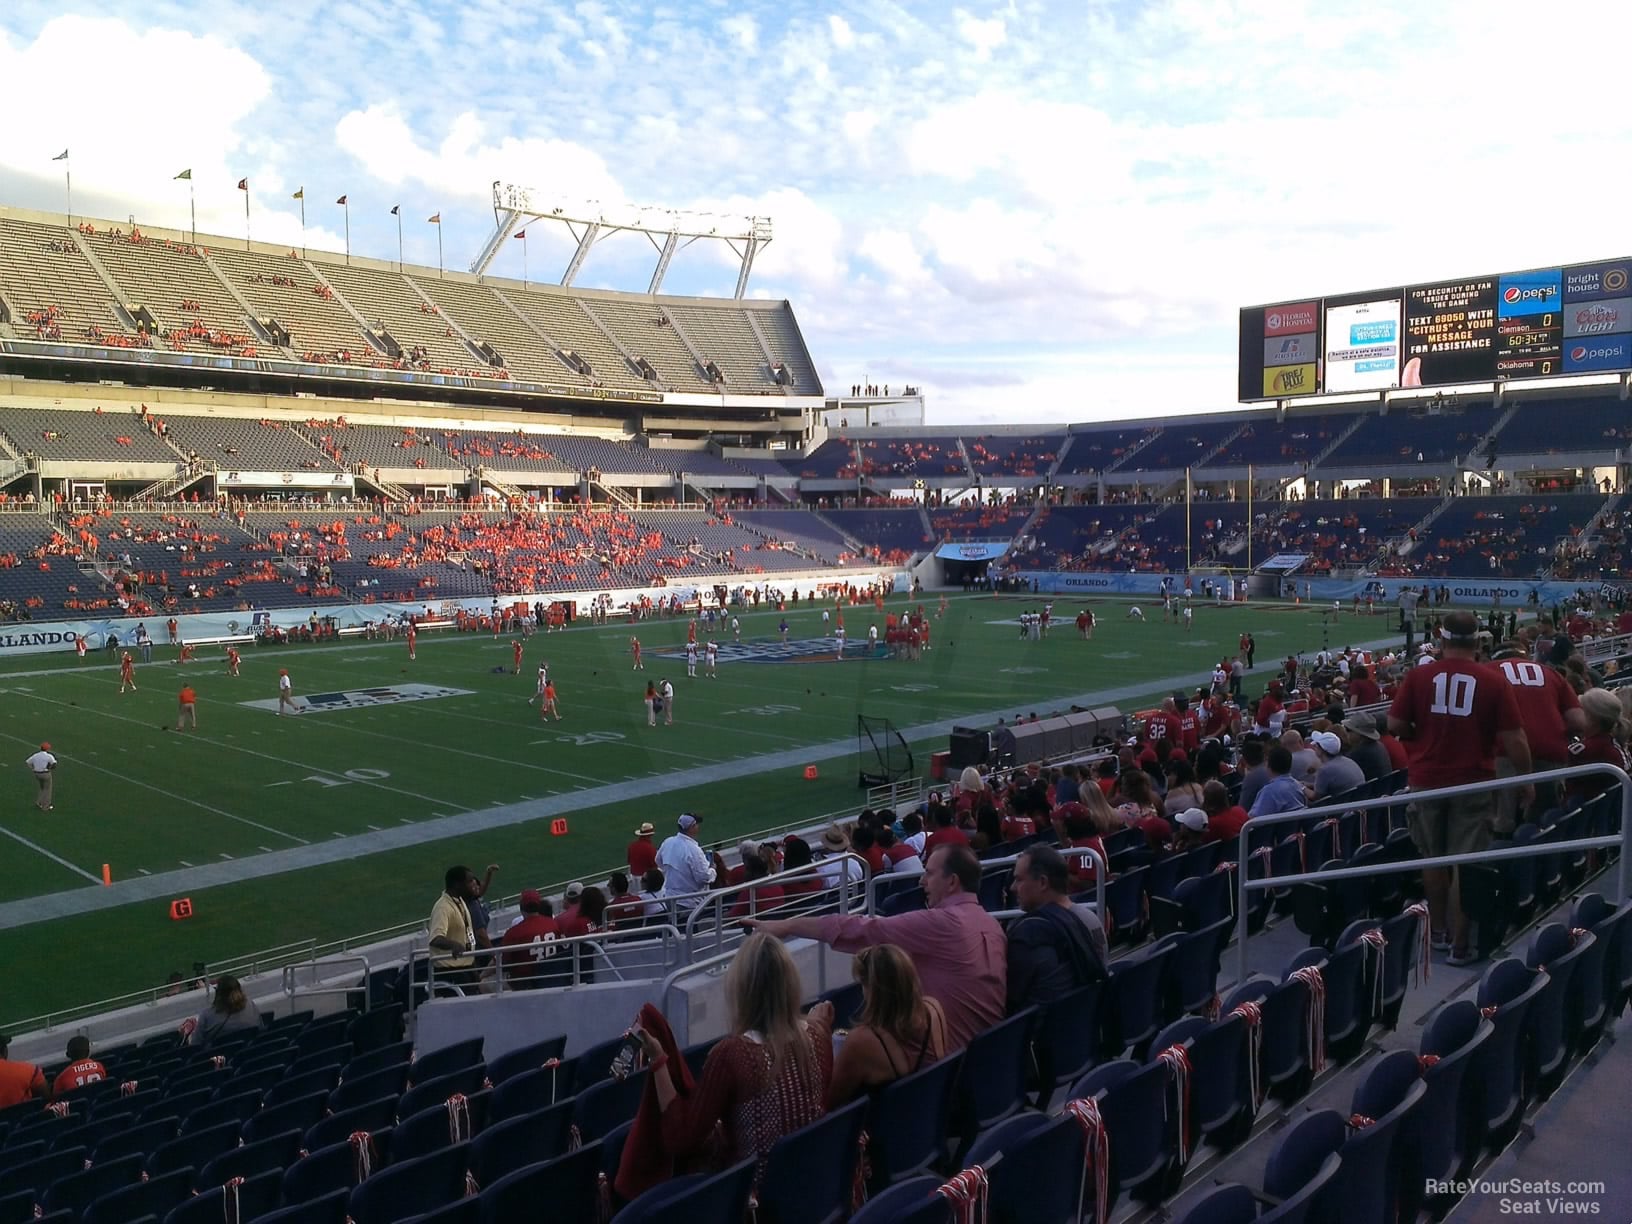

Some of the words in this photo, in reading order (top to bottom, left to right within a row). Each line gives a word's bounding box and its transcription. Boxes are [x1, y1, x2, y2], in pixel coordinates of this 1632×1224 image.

[1568, 272, 1599, 284] bright
[1428, 286, 1463, 296] SECURITY
[1478, 282, 1491, 290] FAN
[1568, 283, 1600, 293] house
[1423, 294, 1449, 303] ISSUES
[1451, 291, 1479, 300] DURING
[1449, 299, 1469, 307] GAME
[1409, 316, 1432, 326] TEXT
[1435, 312, 1465, 323] 69050
[1467, 309, 1493, 320] WITH
[1543, 314, 1552, 326] 0
[1467, 319, 1494, 330] YOUR
[1497, 325, 1530, 334] Clemson
[1578, 321, 1615, 333] LIGHT
[1428, 331, 1473, 343] MESSAGE
[1410, 345, 1428, 354] FOR
[1432, 339, 1491, 352] ASSISTANCE
[1589, 346, 1622, 359] pepsi
[1497, 361, 1534, 370] Oklahoma
[1542, 362, 1551, 374] 0
[1281, 368, 1303, 379] TIRES
[1283, 375, 1303, 391] PLUS
[1066, 578, 1108, 587] ORLANDO
[0, 631, 77, 648] LANDO
[1500, 661, 1545, 687] 10
[1430, 672, 1477, 717] 10
[1150, 724, 1166, 739] 32
[301, 768, 391, 789] 10
[554, 820, 566, 833] 10
[1080, 855, 1093, 869] 10
[175, 901, 190, 916] G
[72, 1062, 98, 1073] TIGERS
